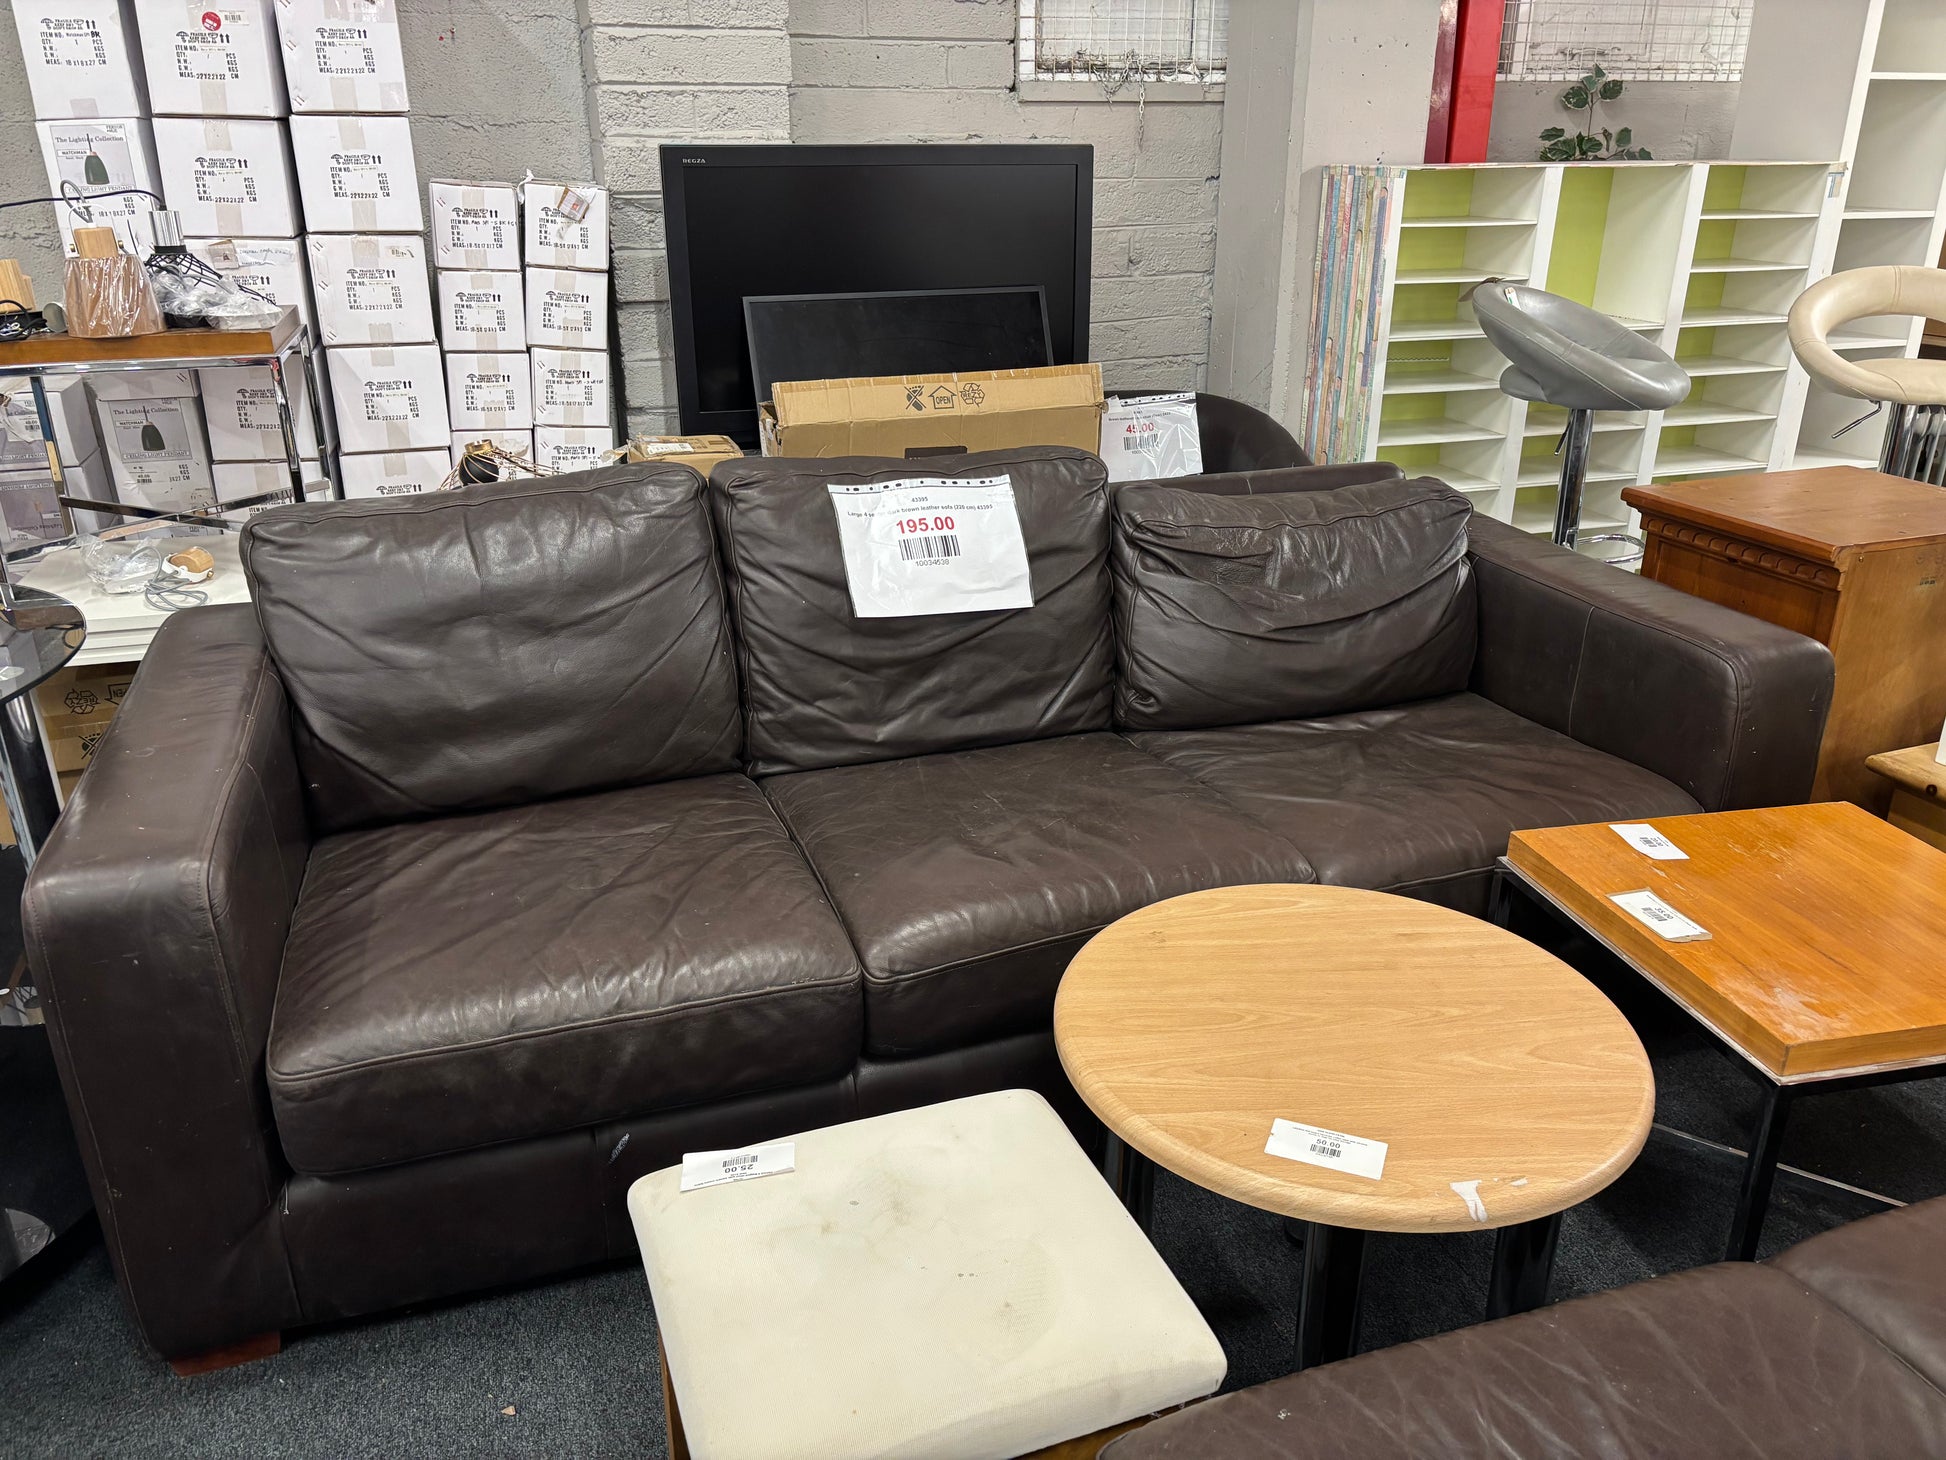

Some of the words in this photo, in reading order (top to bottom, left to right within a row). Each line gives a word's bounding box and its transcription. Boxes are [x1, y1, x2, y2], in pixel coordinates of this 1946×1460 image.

[936, 396, 950, 404] OPEN
[1126, 422, 1154, 433] 45.00
[896, 516, 955, 534] 195.00
[1316, 1139, 1340, 1148] 50.00
[725, 1164, 754, 1173] 25.00
